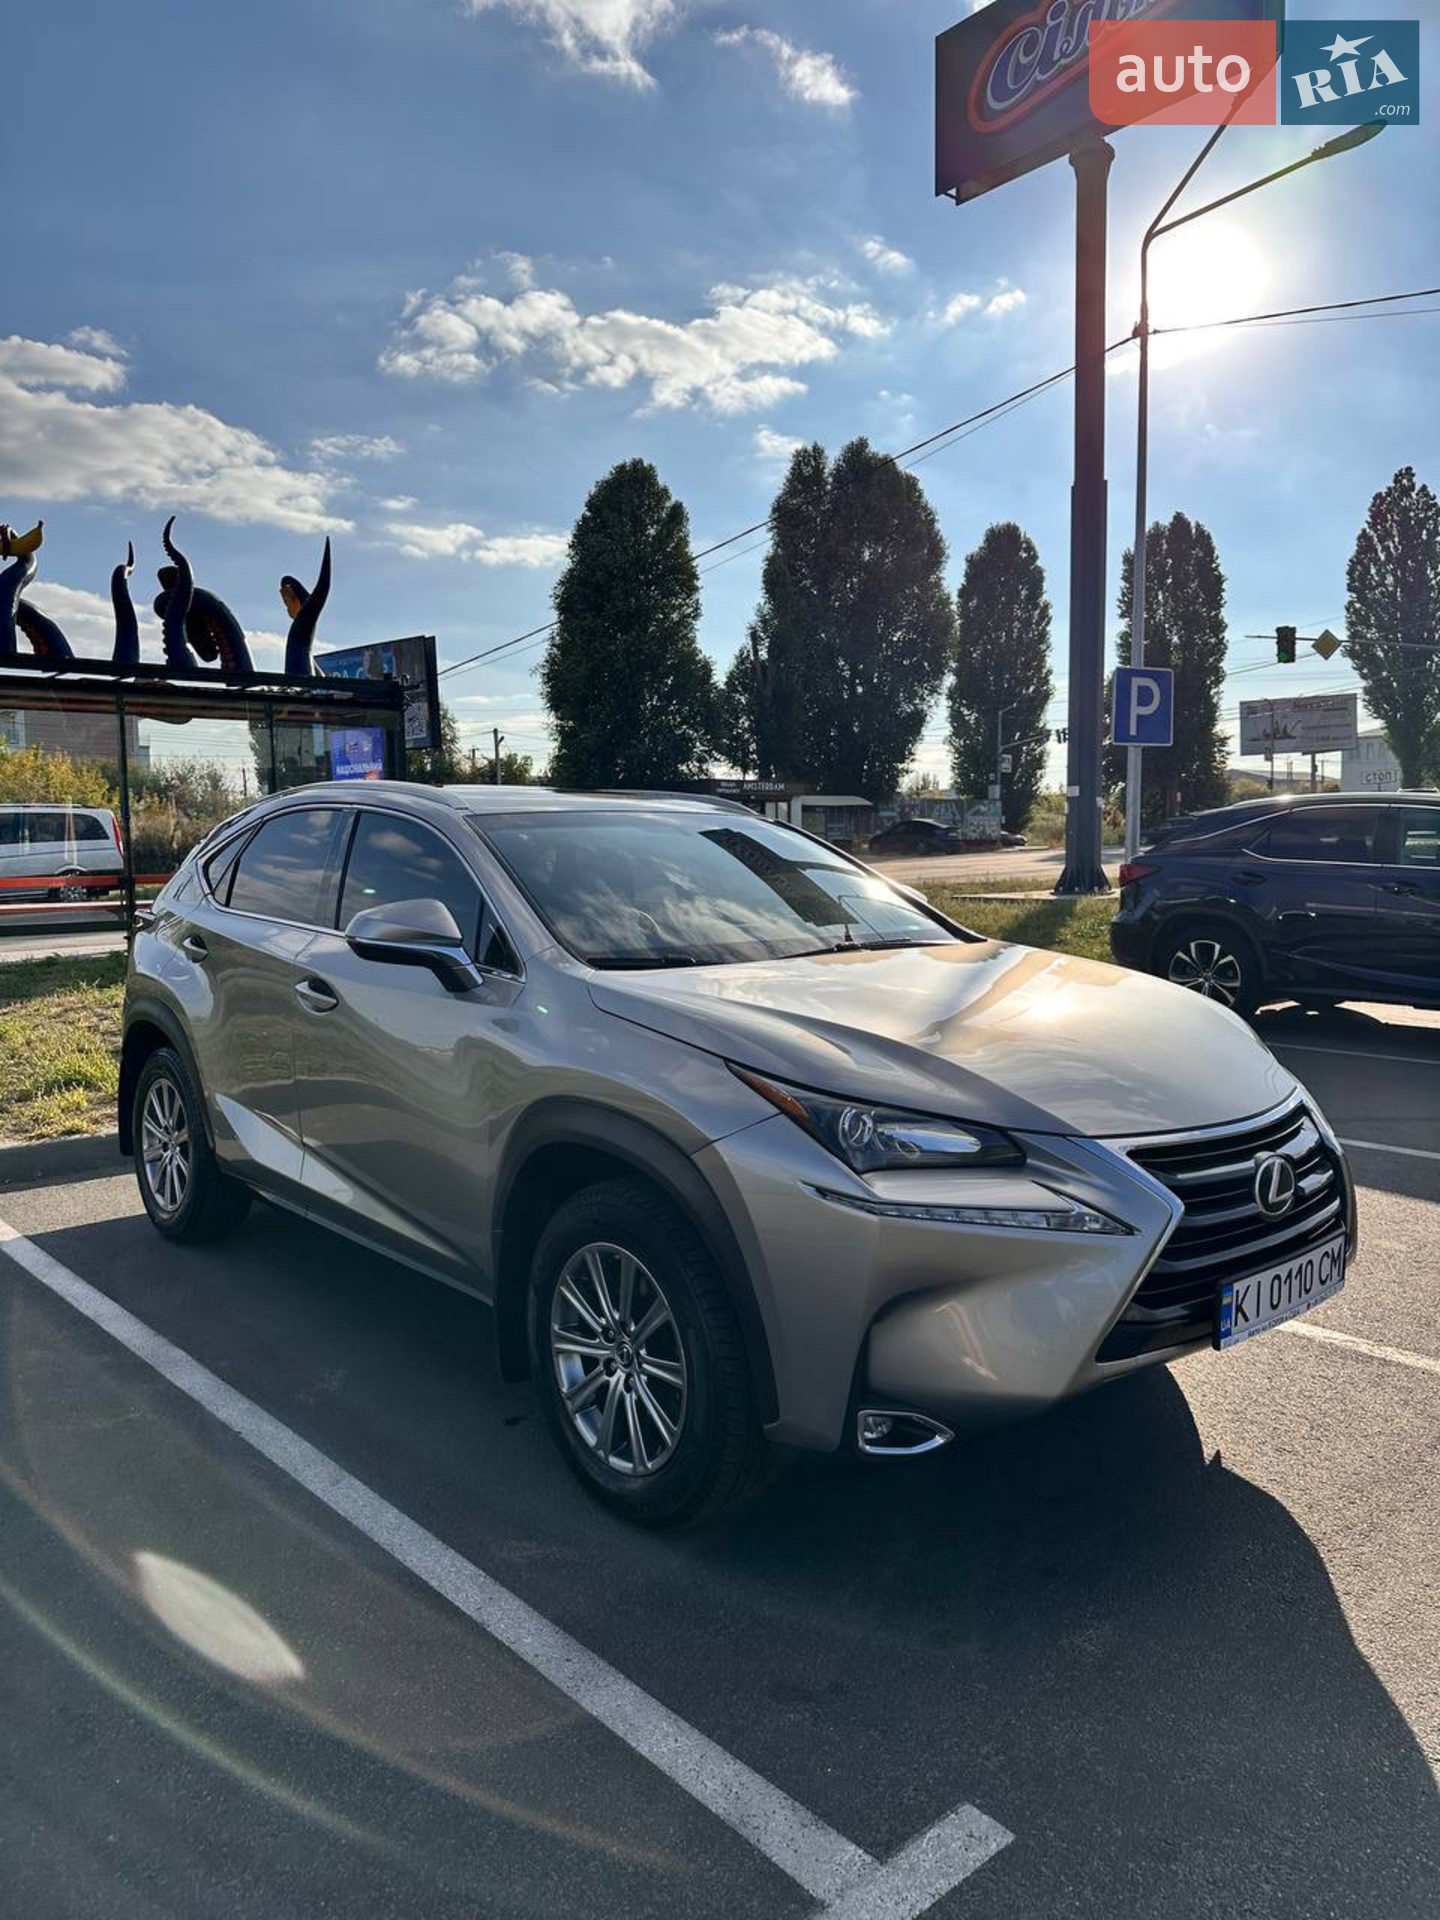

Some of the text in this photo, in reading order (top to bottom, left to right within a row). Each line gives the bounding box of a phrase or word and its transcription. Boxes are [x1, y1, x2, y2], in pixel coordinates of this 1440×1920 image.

[1129, 676, 1161, 736] P
[743, 782, 786, 791] AMSTERDAM
[1234, 1280, 1261, 1327] KI
[1270, 1259, 1314, 1311] 0110
[1318, 1243, 1343, 1286] CM
